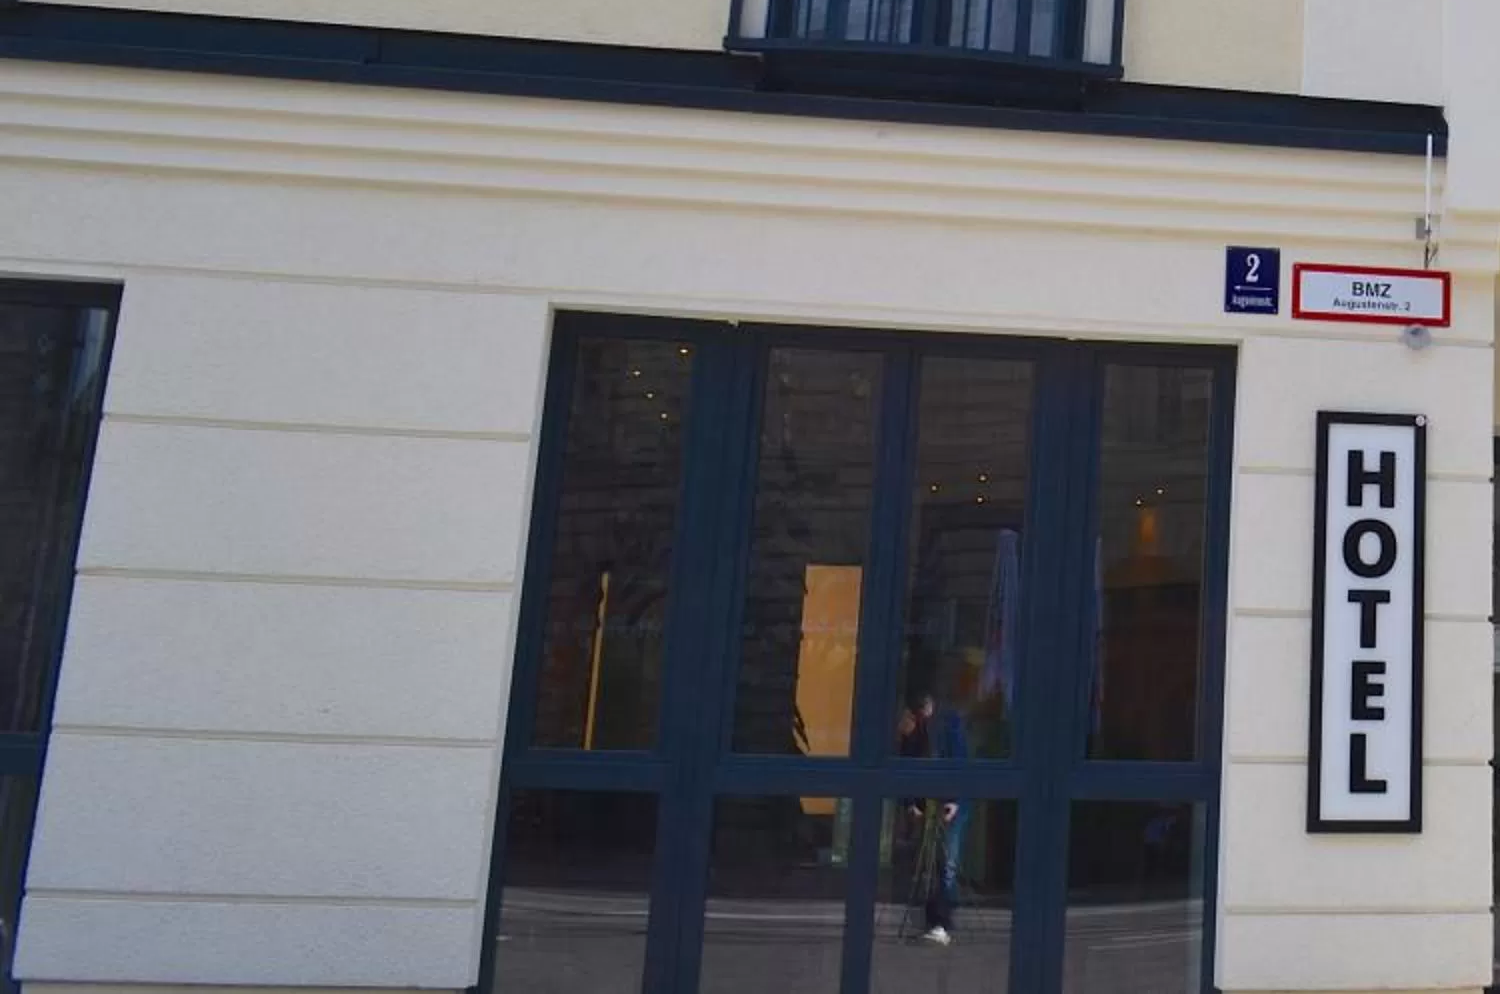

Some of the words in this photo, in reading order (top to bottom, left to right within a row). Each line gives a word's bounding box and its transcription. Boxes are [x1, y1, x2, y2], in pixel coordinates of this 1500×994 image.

[1245, 253, 1261, 283] 2
[1351, 281, 1393, 299] BMZ
[1342, 449, 1397, 794] HOTEL
